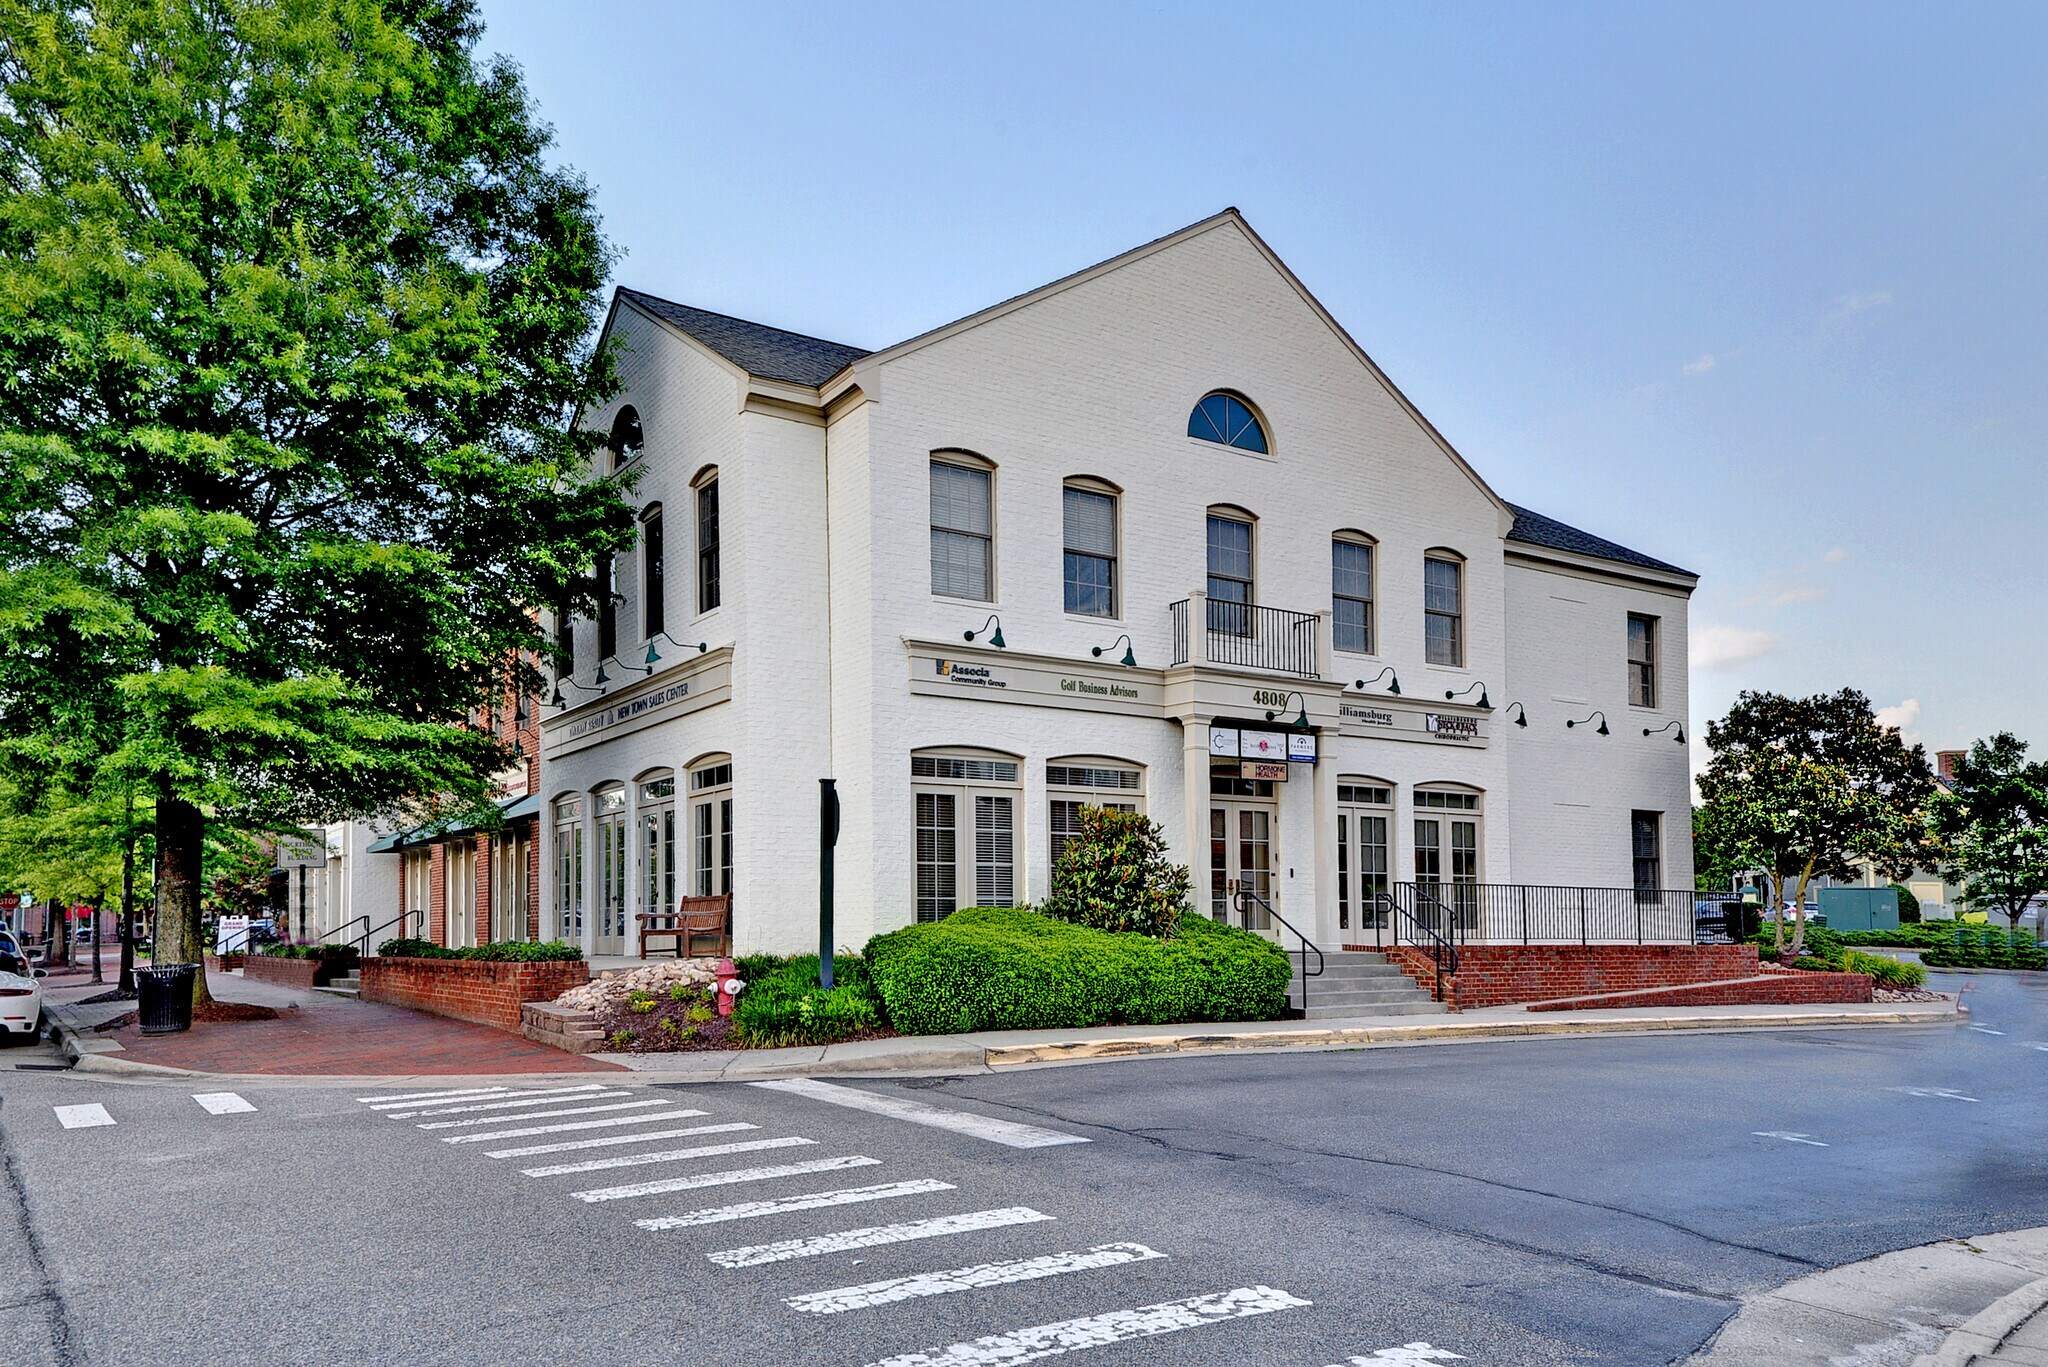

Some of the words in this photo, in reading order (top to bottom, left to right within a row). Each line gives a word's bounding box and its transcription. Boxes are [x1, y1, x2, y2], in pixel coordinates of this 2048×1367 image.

[951, 664, 990, 677] Associa
[951, 675, 986, 686] Community
[988, 679, 1006, 688] Group
[1061, 679, 1076, 691] Golf
[1079, 681, 1108, 695] Business
[1110, 684, 1138, 698] Advisors
[617, 706, 630, 719] NEW
[631, 700, 648, 715] TOWN
[649, 692, 664, 708] SALES
[666, 683, 689, 702] CENTER
[1253, 690, 1286, 707] 4808
[1340, 706, 1393, 721] illiamsburg
[1255, 764, 1285, 773] HORMONE
[1255, 770, 1279, 778] HEALTH
